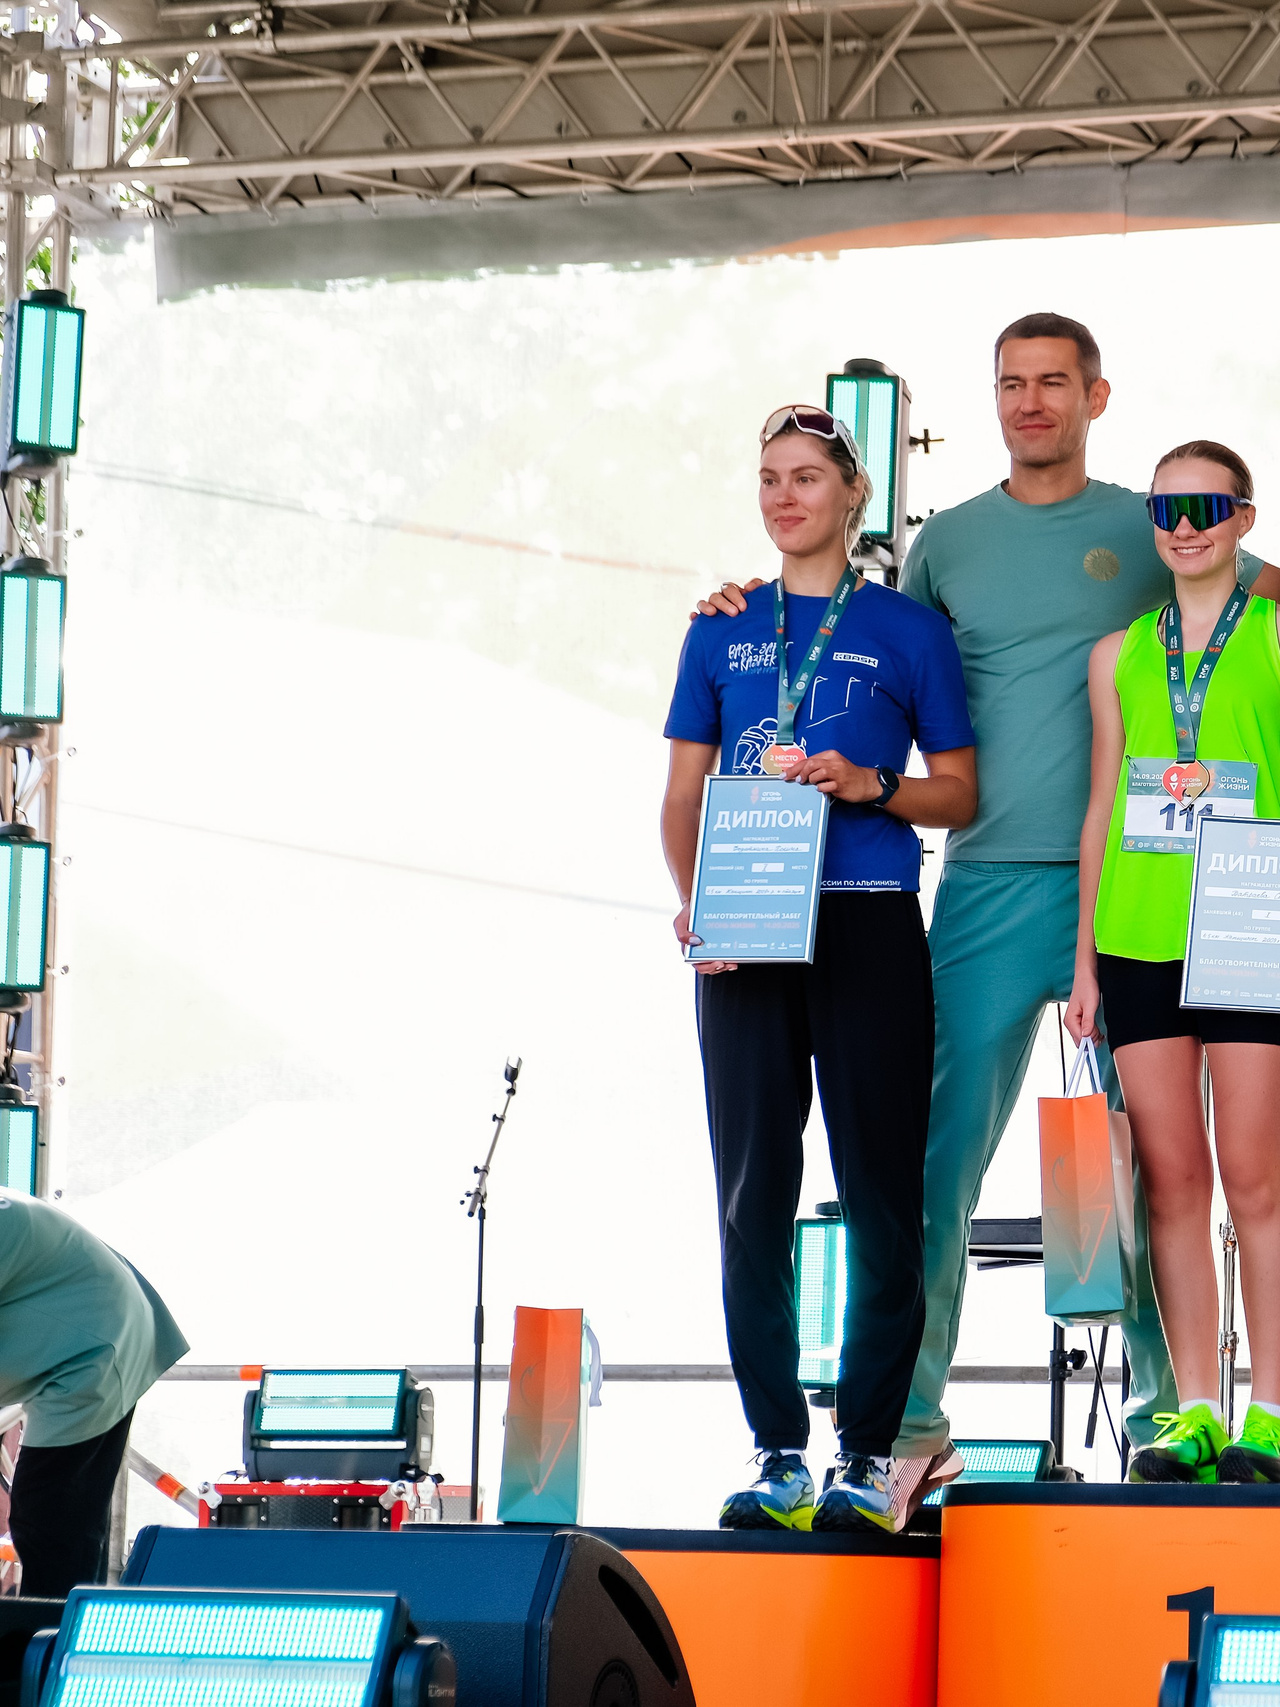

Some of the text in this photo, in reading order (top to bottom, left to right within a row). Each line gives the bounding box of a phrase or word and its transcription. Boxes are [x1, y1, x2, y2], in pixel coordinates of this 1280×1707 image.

[1220, 776, 1248, 784] ОГОНЬ
[1218, 783, 1250, 791] ЖИЗНИ
[713, 809, 813, 831] ДИПЛОМ
[703, 911, 780, 920] БЛАГОТВОРИТЕЛЬНЫЙ
[1167, 1586, 1215, 1661] 1
